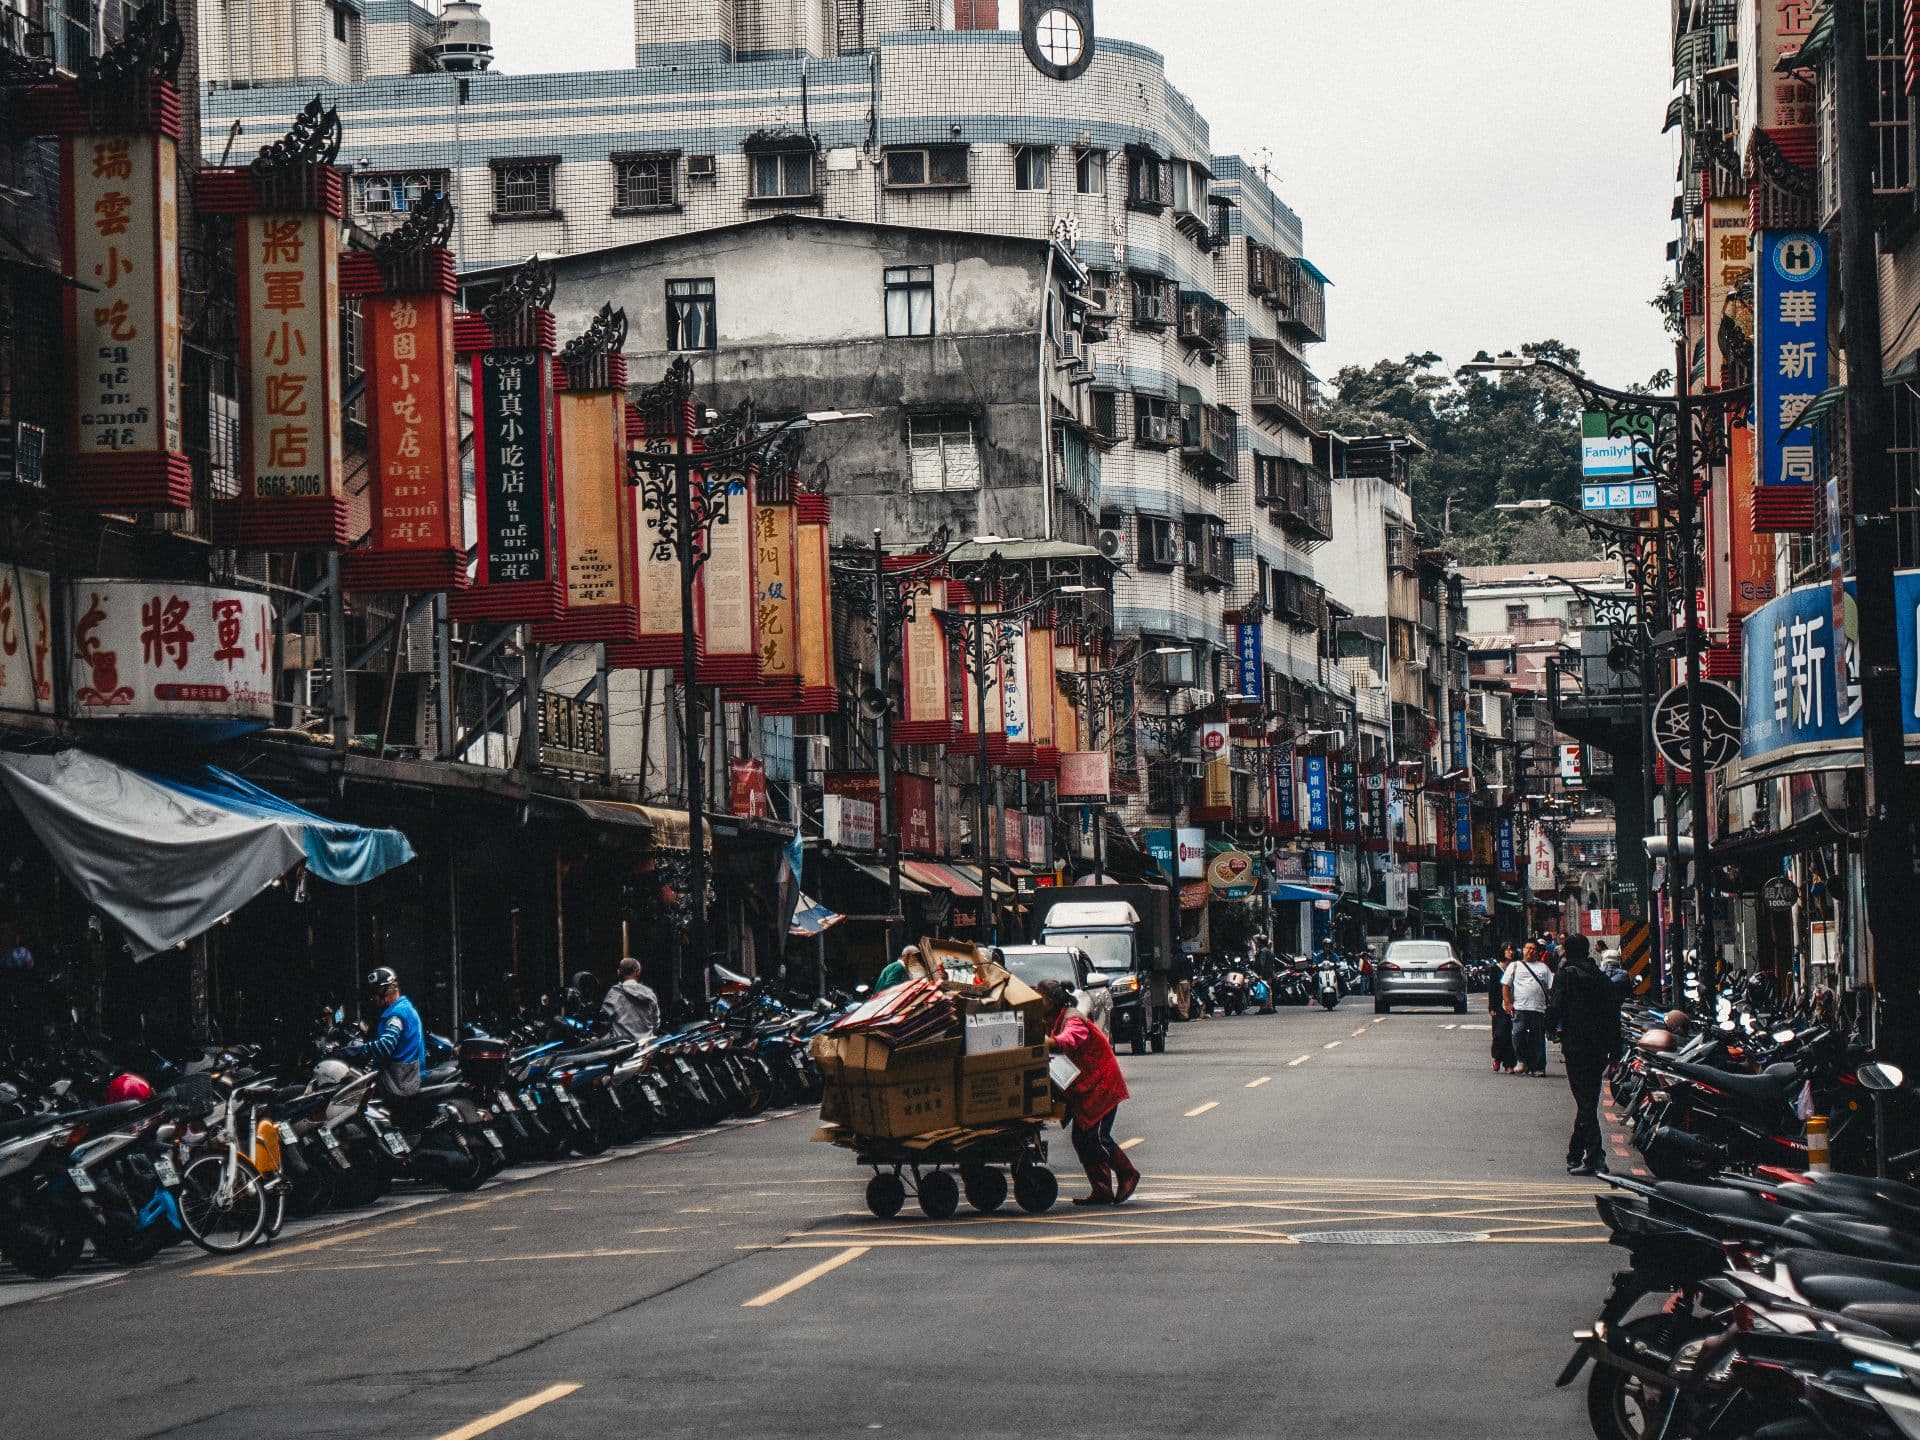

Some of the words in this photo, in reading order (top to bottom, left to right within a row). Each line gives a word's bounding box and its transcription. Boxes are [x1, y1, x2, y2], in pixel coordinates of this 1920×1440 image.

[92, 141, 136, 341] 瑞雲小吃
[1713, 217, 1747, 228] LUCKY
[262, 220, 307, 469] 將軍小吃店
[1779, 290, 1817, 481] 華新藥局
[257, 476, 320, 496] 8668-3006
[497, 367, 525, 493] 清真小吃店
[1636, 490, 1651, 499] ATM
